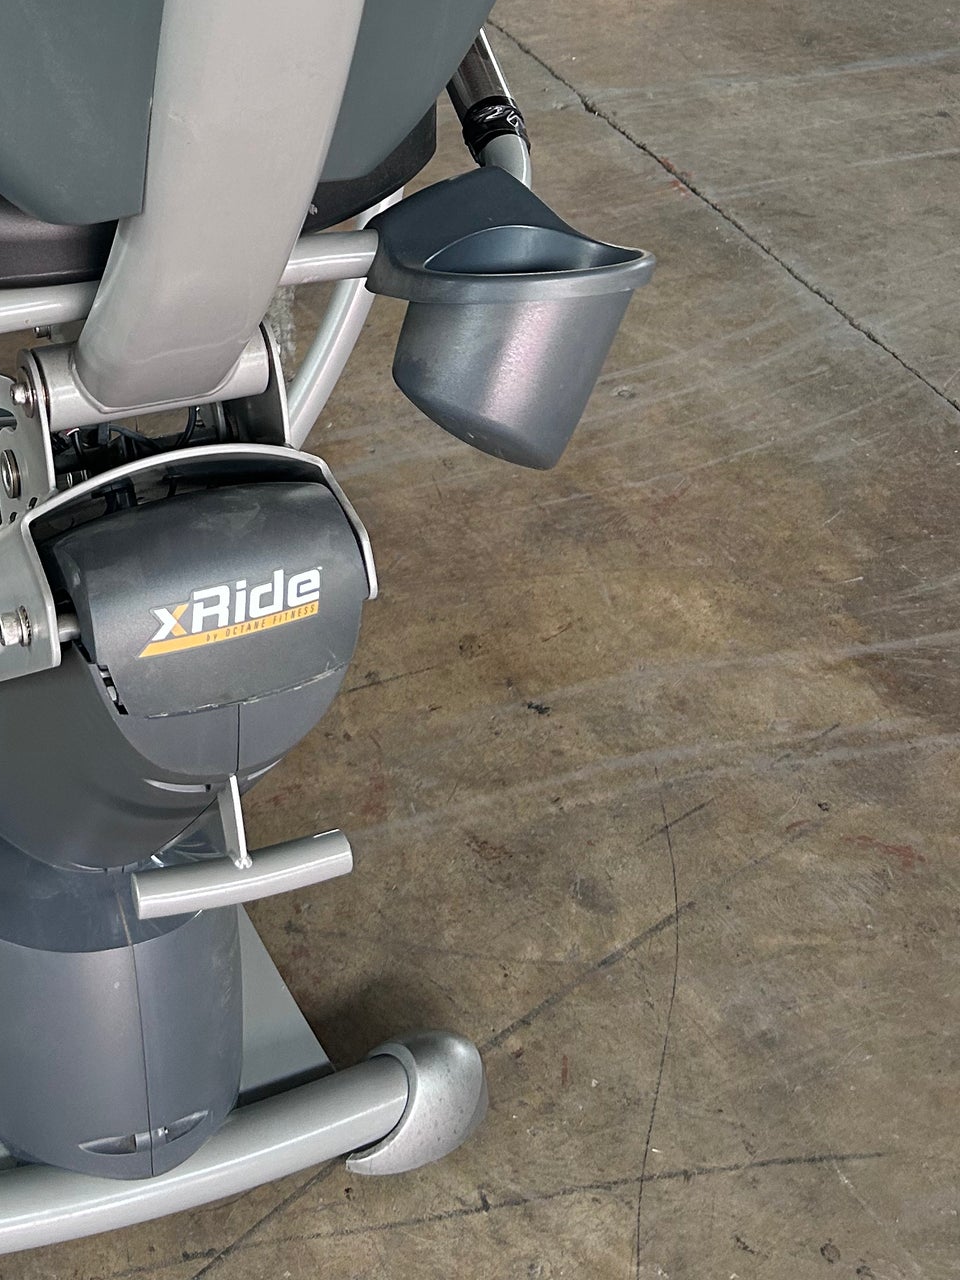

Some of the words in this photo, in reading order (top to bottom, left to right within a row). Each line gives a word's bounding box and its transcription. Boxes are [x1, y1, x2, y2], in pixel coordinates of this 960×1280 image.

[152, 569, 320, 641] xRide
[206, 632, 217, 642] by
[225, 620, 266, 637] OCTANE
[272, 604, 316, 625] FITNESS
